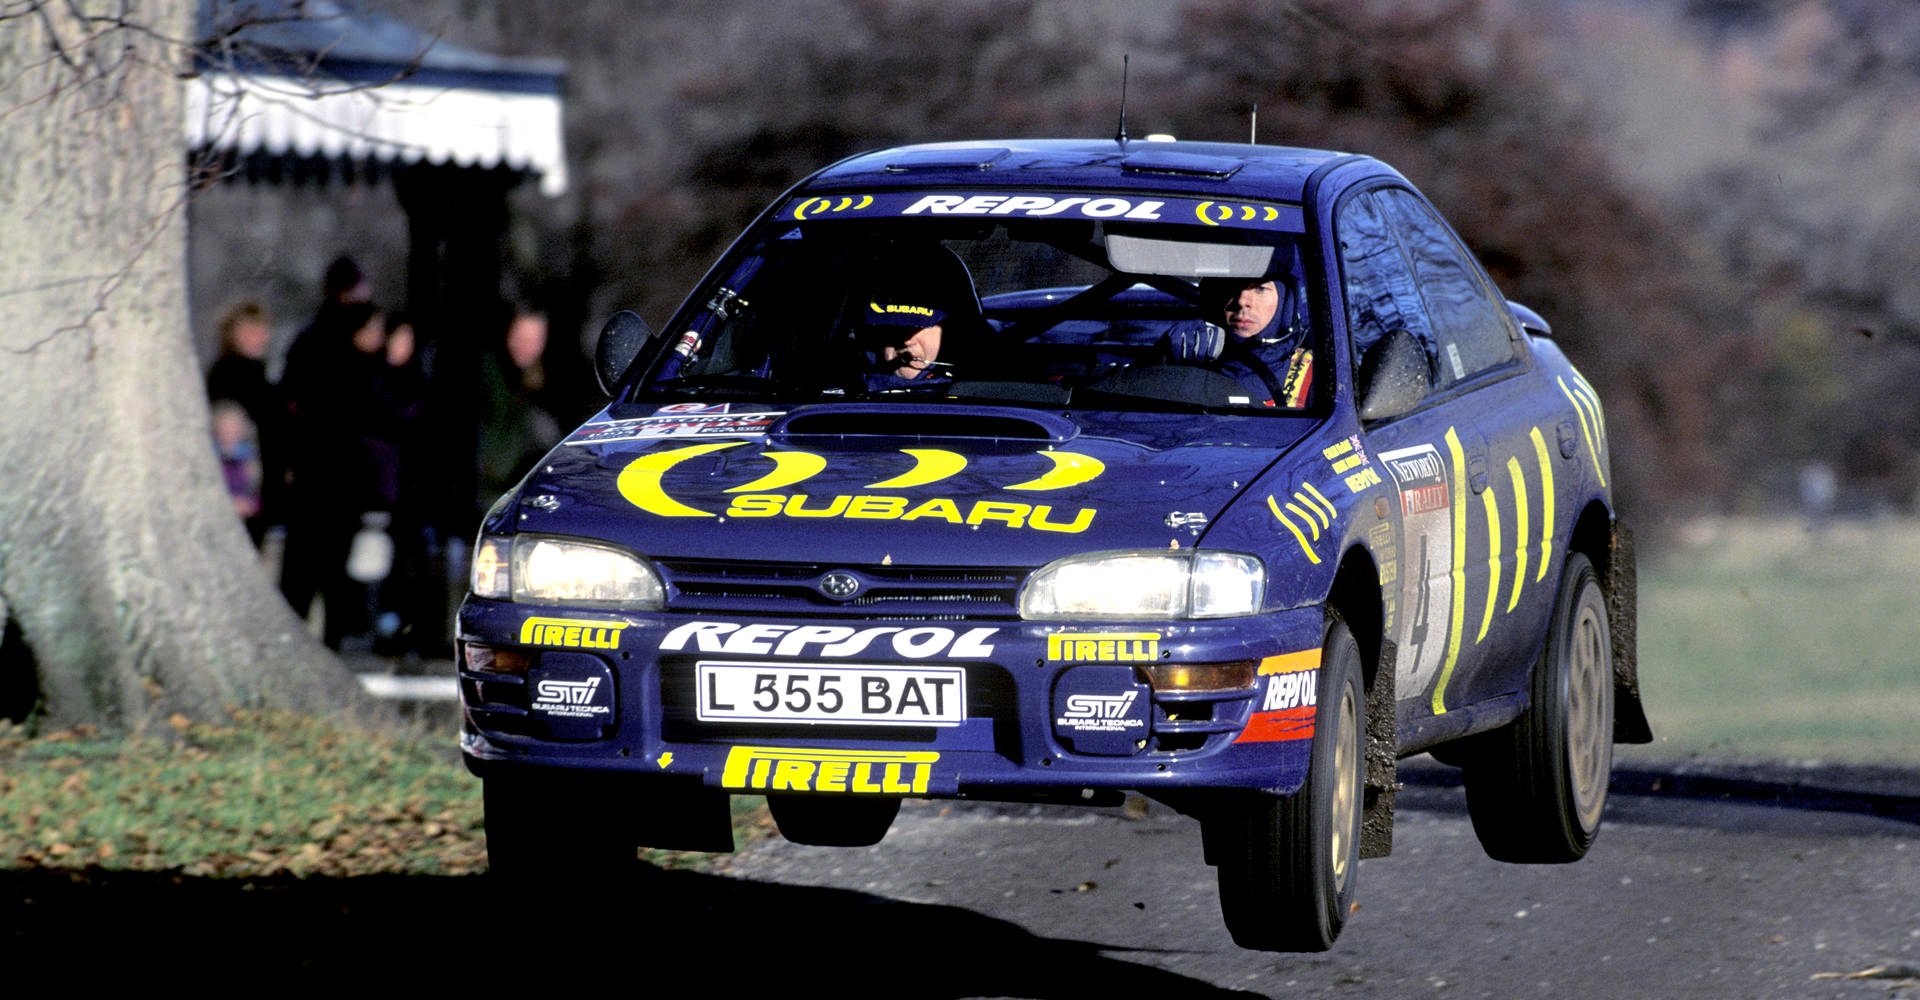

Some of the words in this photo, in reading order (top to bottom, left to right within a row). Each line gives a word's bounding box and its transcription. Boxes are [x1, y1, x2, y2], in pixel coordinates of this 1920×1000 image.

[901, 195, 1165, 220] REPSOL
[886, 304, 934, 317] SUBARU
[726, 494, 1096, 534] SUBARU
[1414, 486, 1443, 512] RALLY
[1411, 535, 1430, 674] 4
[520, 616, 630, 650] PIRELLI
[659, 621, 1000, 659] REPSOL
[1047, 632, 1162, 661] PIRELLI
[708, 672, 735, 711] L
[753, 674, 843, 714] 555
[861, 676, 954, 716] BAT
[1262, 670, 1317, 711] REPSOL
[721, 745, 941, 794] PIRELLI
